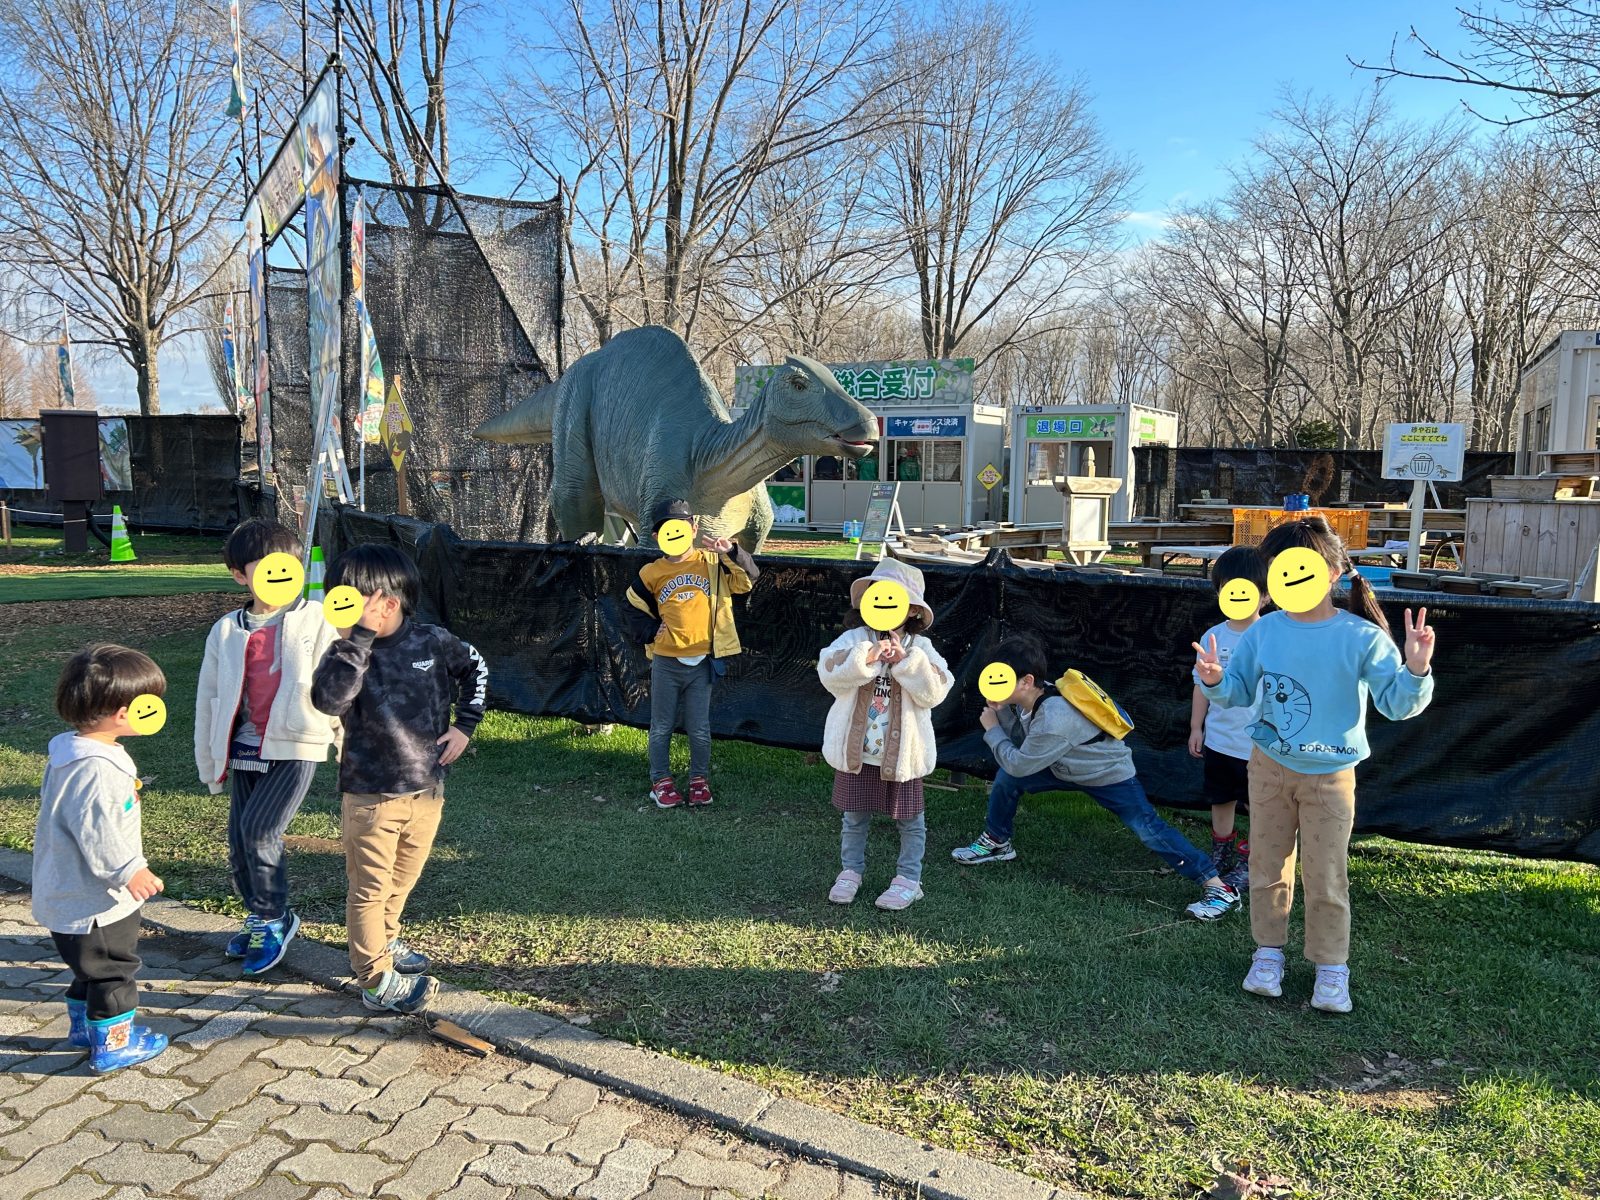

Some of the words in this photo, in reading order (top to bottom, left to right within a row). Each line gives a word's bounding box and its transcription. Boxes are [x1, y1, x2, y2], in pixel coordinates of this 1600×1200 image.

[1036, 420, 1083, 434] 退場口
[677, 591, 695, 601] NYC
[1298, 743, 1359, 755] DORAEMON
